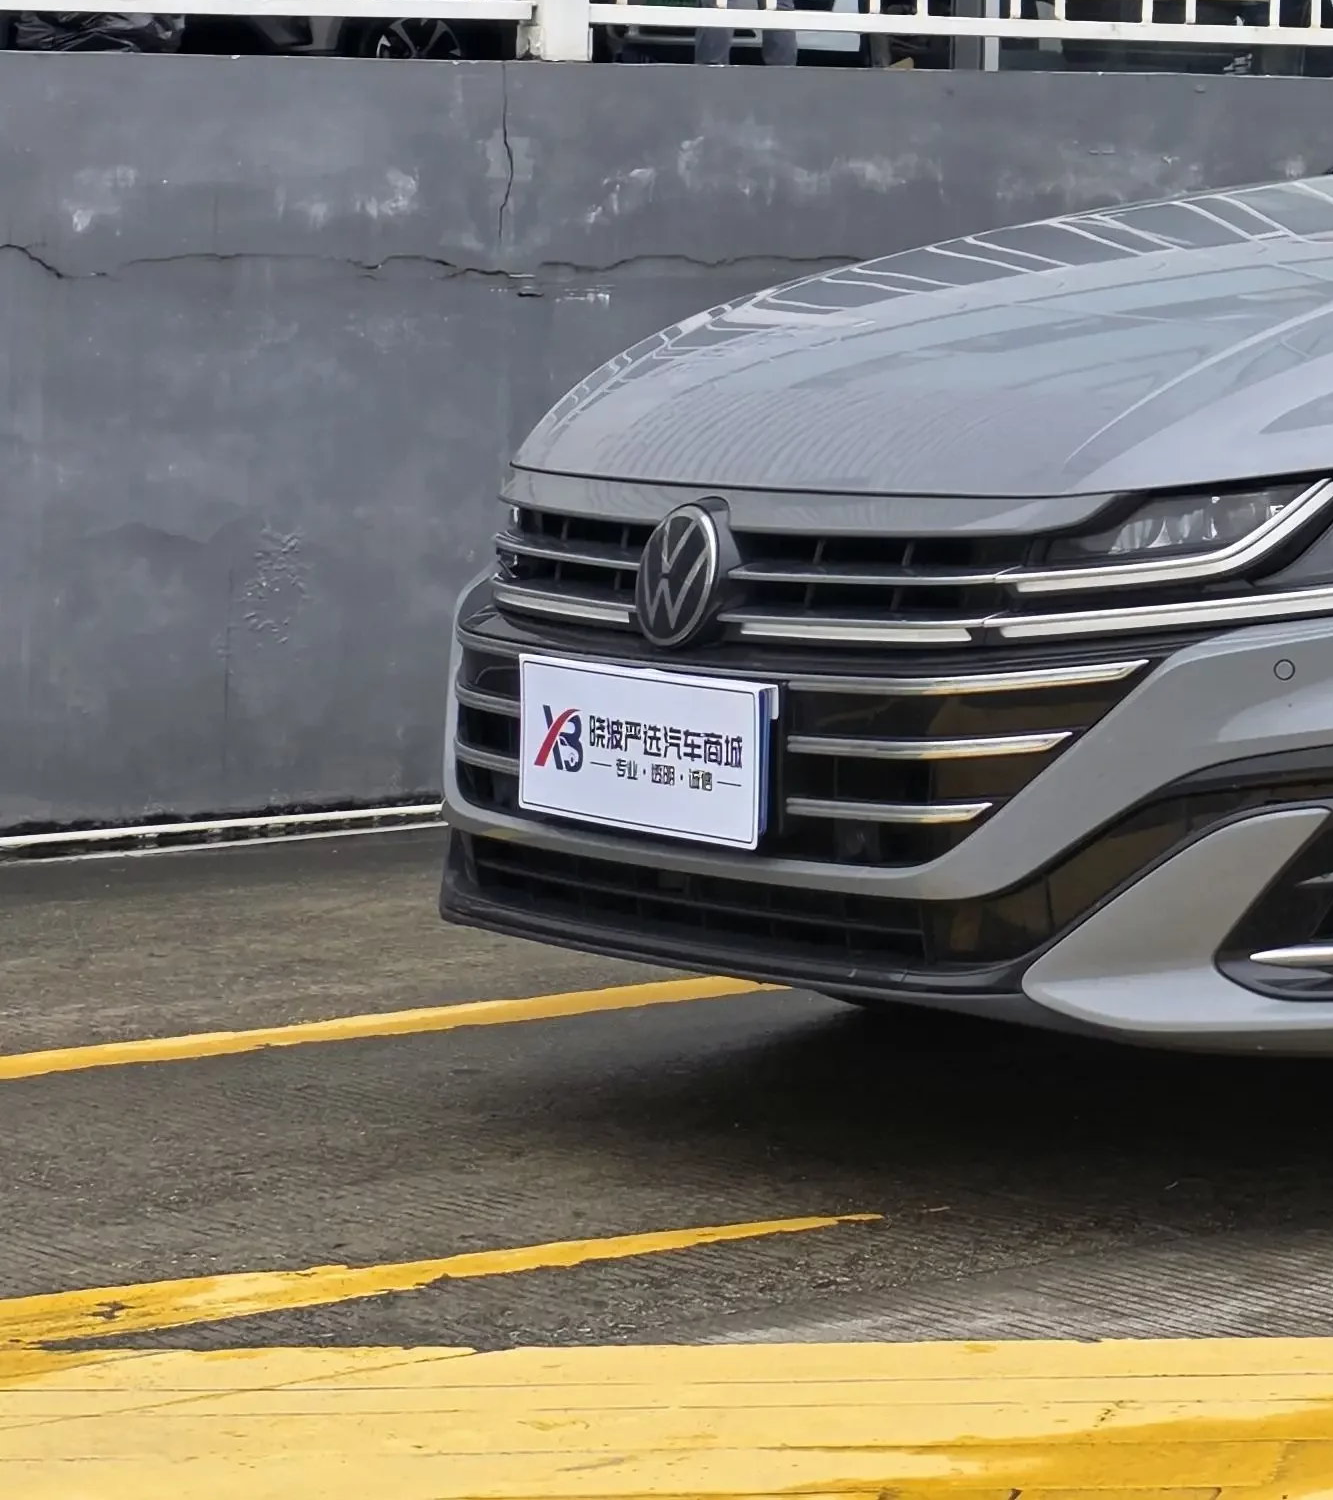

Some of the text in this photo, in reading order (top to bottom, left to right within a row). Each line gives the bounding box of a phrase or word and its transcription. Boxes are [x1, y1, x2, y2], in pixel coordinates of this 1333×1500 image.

[589, 714, 743, 769] 晓波严选汽车商城
